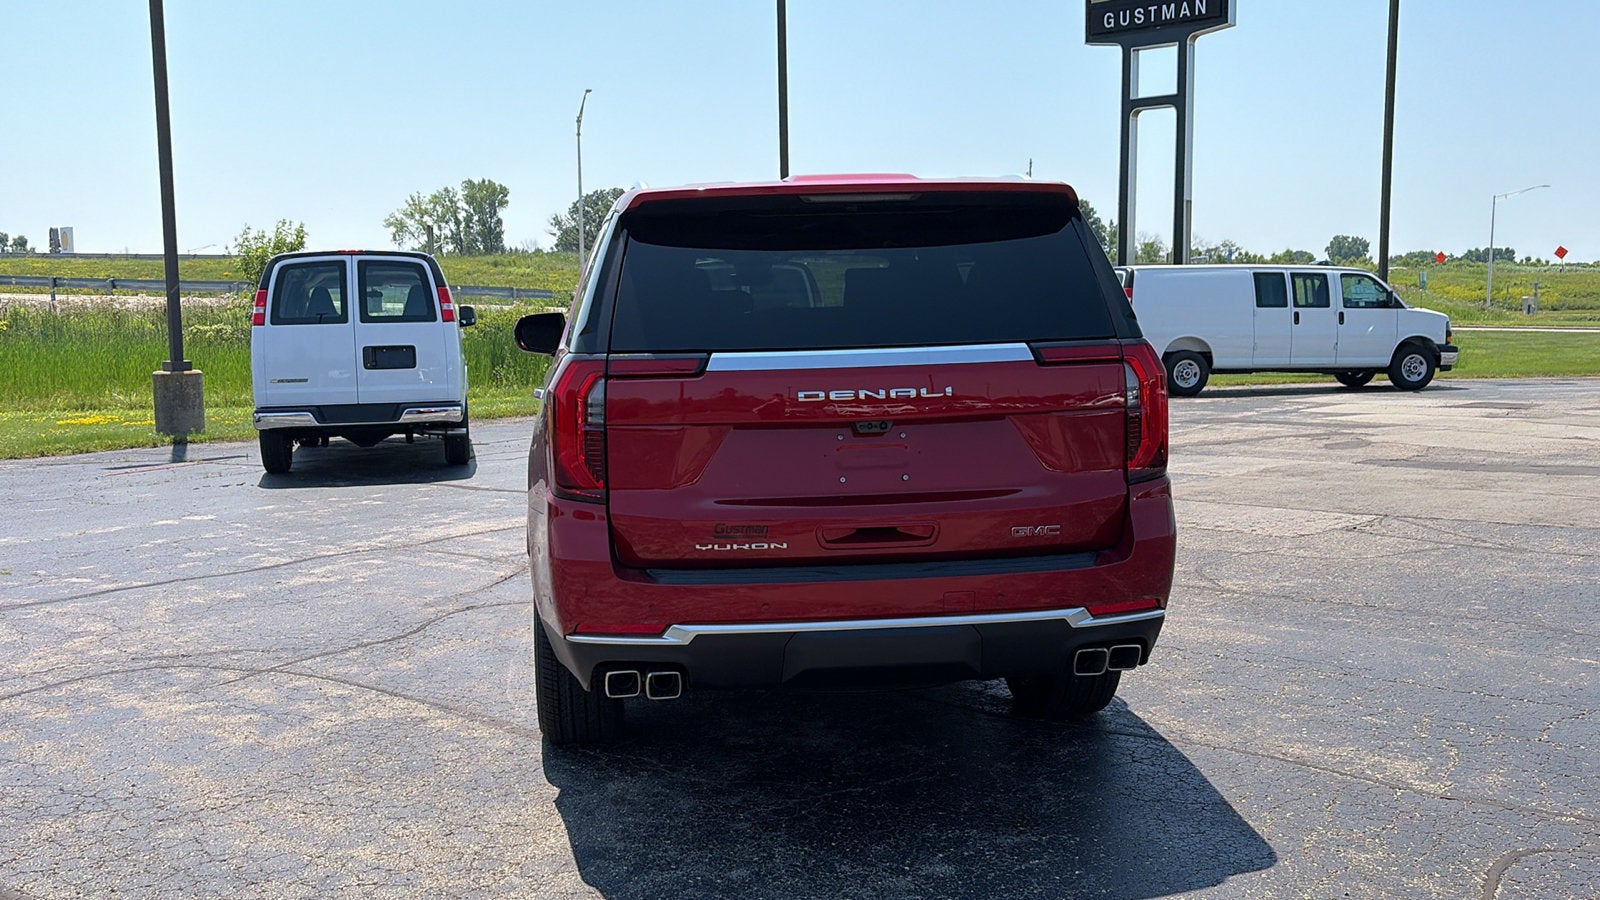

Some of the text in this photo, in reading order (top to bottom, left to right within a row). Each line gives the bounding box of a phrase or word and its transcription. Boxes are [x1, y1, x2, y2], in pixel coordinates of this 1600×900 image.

[1103, 0, 1207, 29] GUSTMAN
[797, 386, 953, 402] DENALI
[1011, 524, 1061, 537] GMC
[695, 542, 788, 552] YUKON
